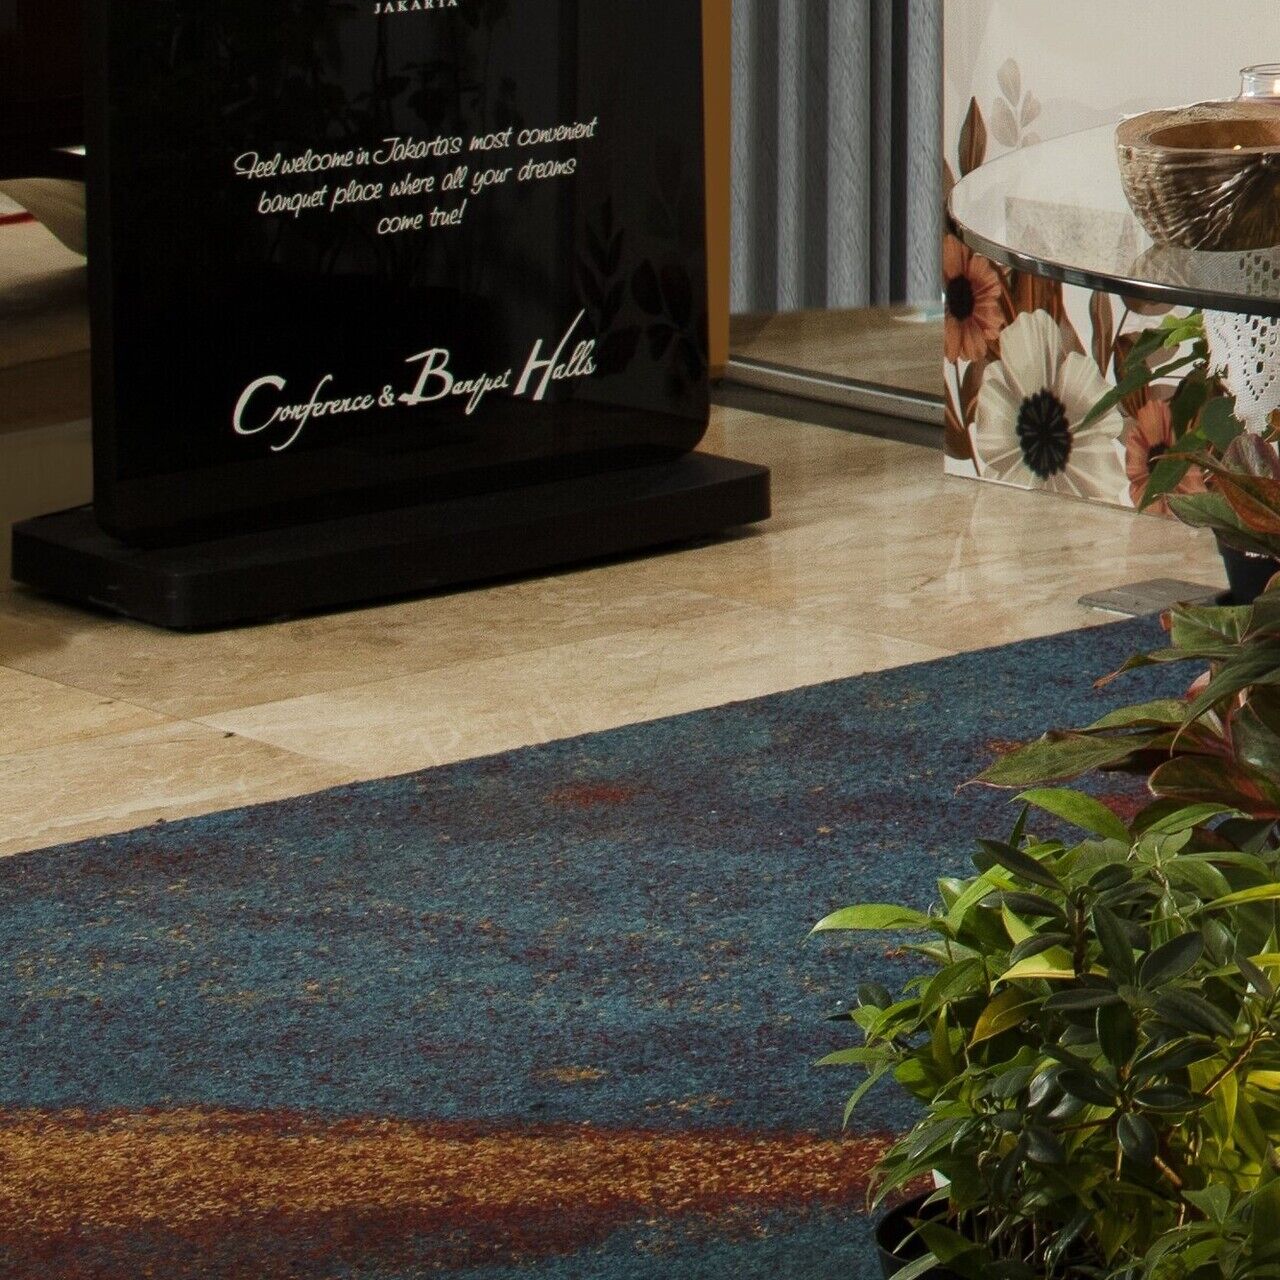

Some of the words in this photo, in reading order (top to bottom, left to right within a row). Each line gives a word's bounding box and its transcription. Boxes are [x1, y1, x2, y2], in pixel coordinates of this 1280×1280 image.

[233, 151, 281, 179] Feel
[281, 148, 354, 175] welcome
[356, 147, 370, 166] in
[373, 136, 463, 166] Jakarta's
[468, 126, 514, 151] most
[517, 116, 598, 146] convenient
[257, 183, 329, 219] banquet
[330, 178, 383, 213] place
[389, 172, 435, 197] where
[441, 165, 468, 192] all
[470, 166, 513, 195] your
[517, 157, 577, 182] dreams
[377, 213, 423, 236] come
[429, 197, 468, 227] true!
[233, 374, 374, 452] Conference
[377, 384, 395, 408] &
[398, 348, 512, 416] Banquet
[513, 308, 597, 400] Halls
